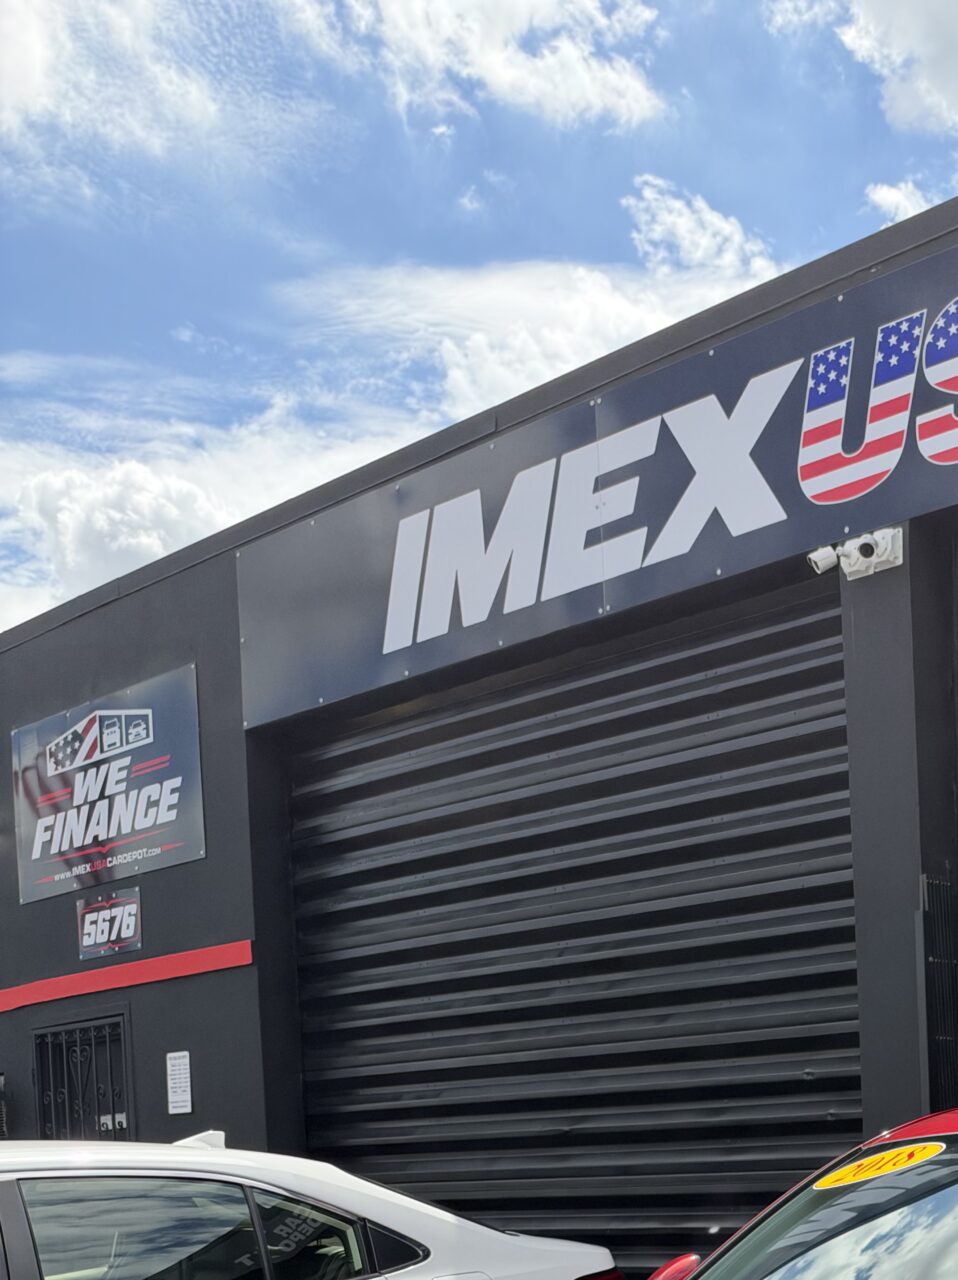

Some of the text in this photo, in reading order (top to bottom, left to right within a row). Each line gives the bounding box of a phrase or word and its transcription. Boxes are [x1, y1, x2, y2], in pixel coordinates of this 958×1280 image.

[73, 756, 132, 807] WE
[31, 776, 183, 861] FINANCE
[82, 903, 137, 946] 5676
